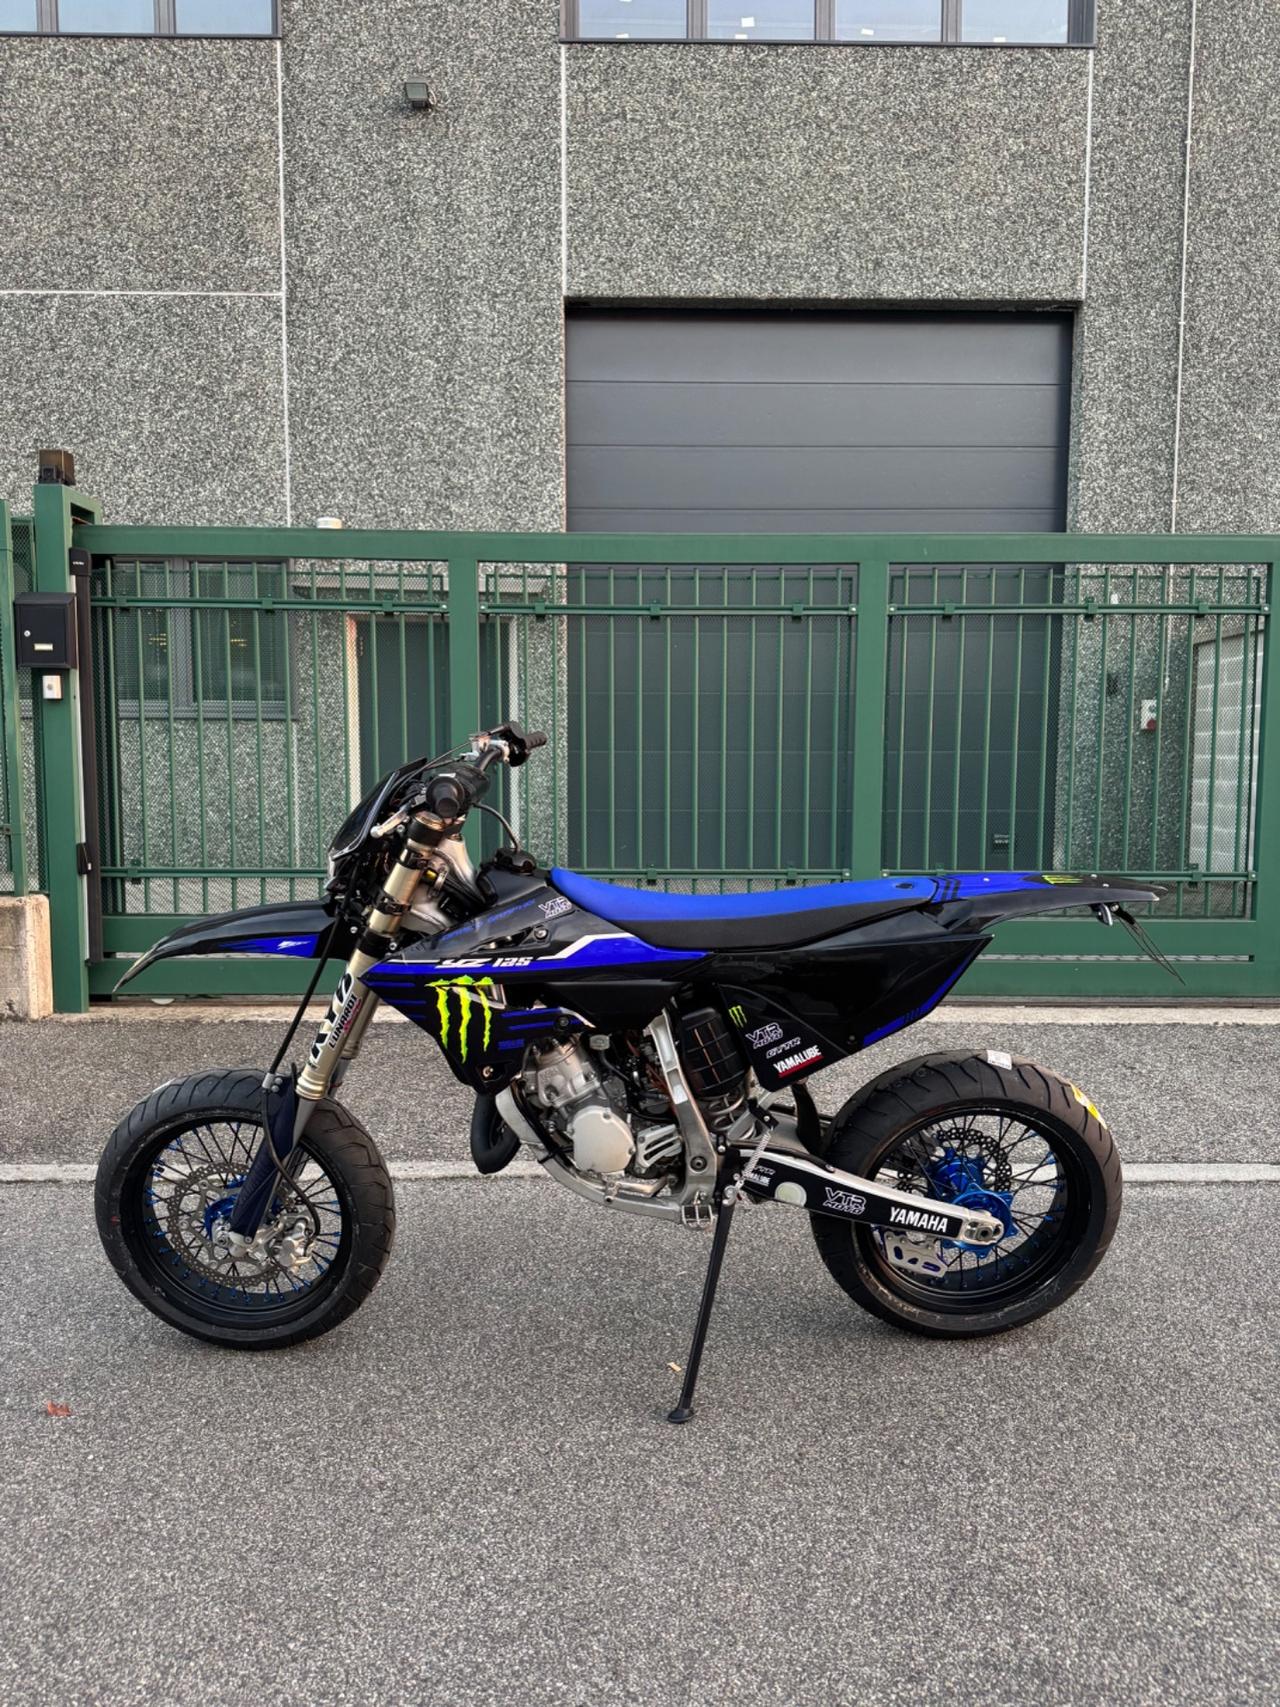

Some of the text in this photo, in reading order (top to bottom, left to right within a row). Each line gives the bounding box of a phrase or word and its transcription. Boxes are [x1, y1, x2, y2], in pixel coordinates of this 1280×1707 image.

[434, 957, 534, 969] YZ 125
[328, 993, 358, 1049] LUNARDI
[745, 1022, 782, 1043] VTR
[773, 1045, 822, 1073] YAMALUBE
[825, 1187, 866, 1207] VTR
[890, 1206, 948, 1233] YAMAHA
